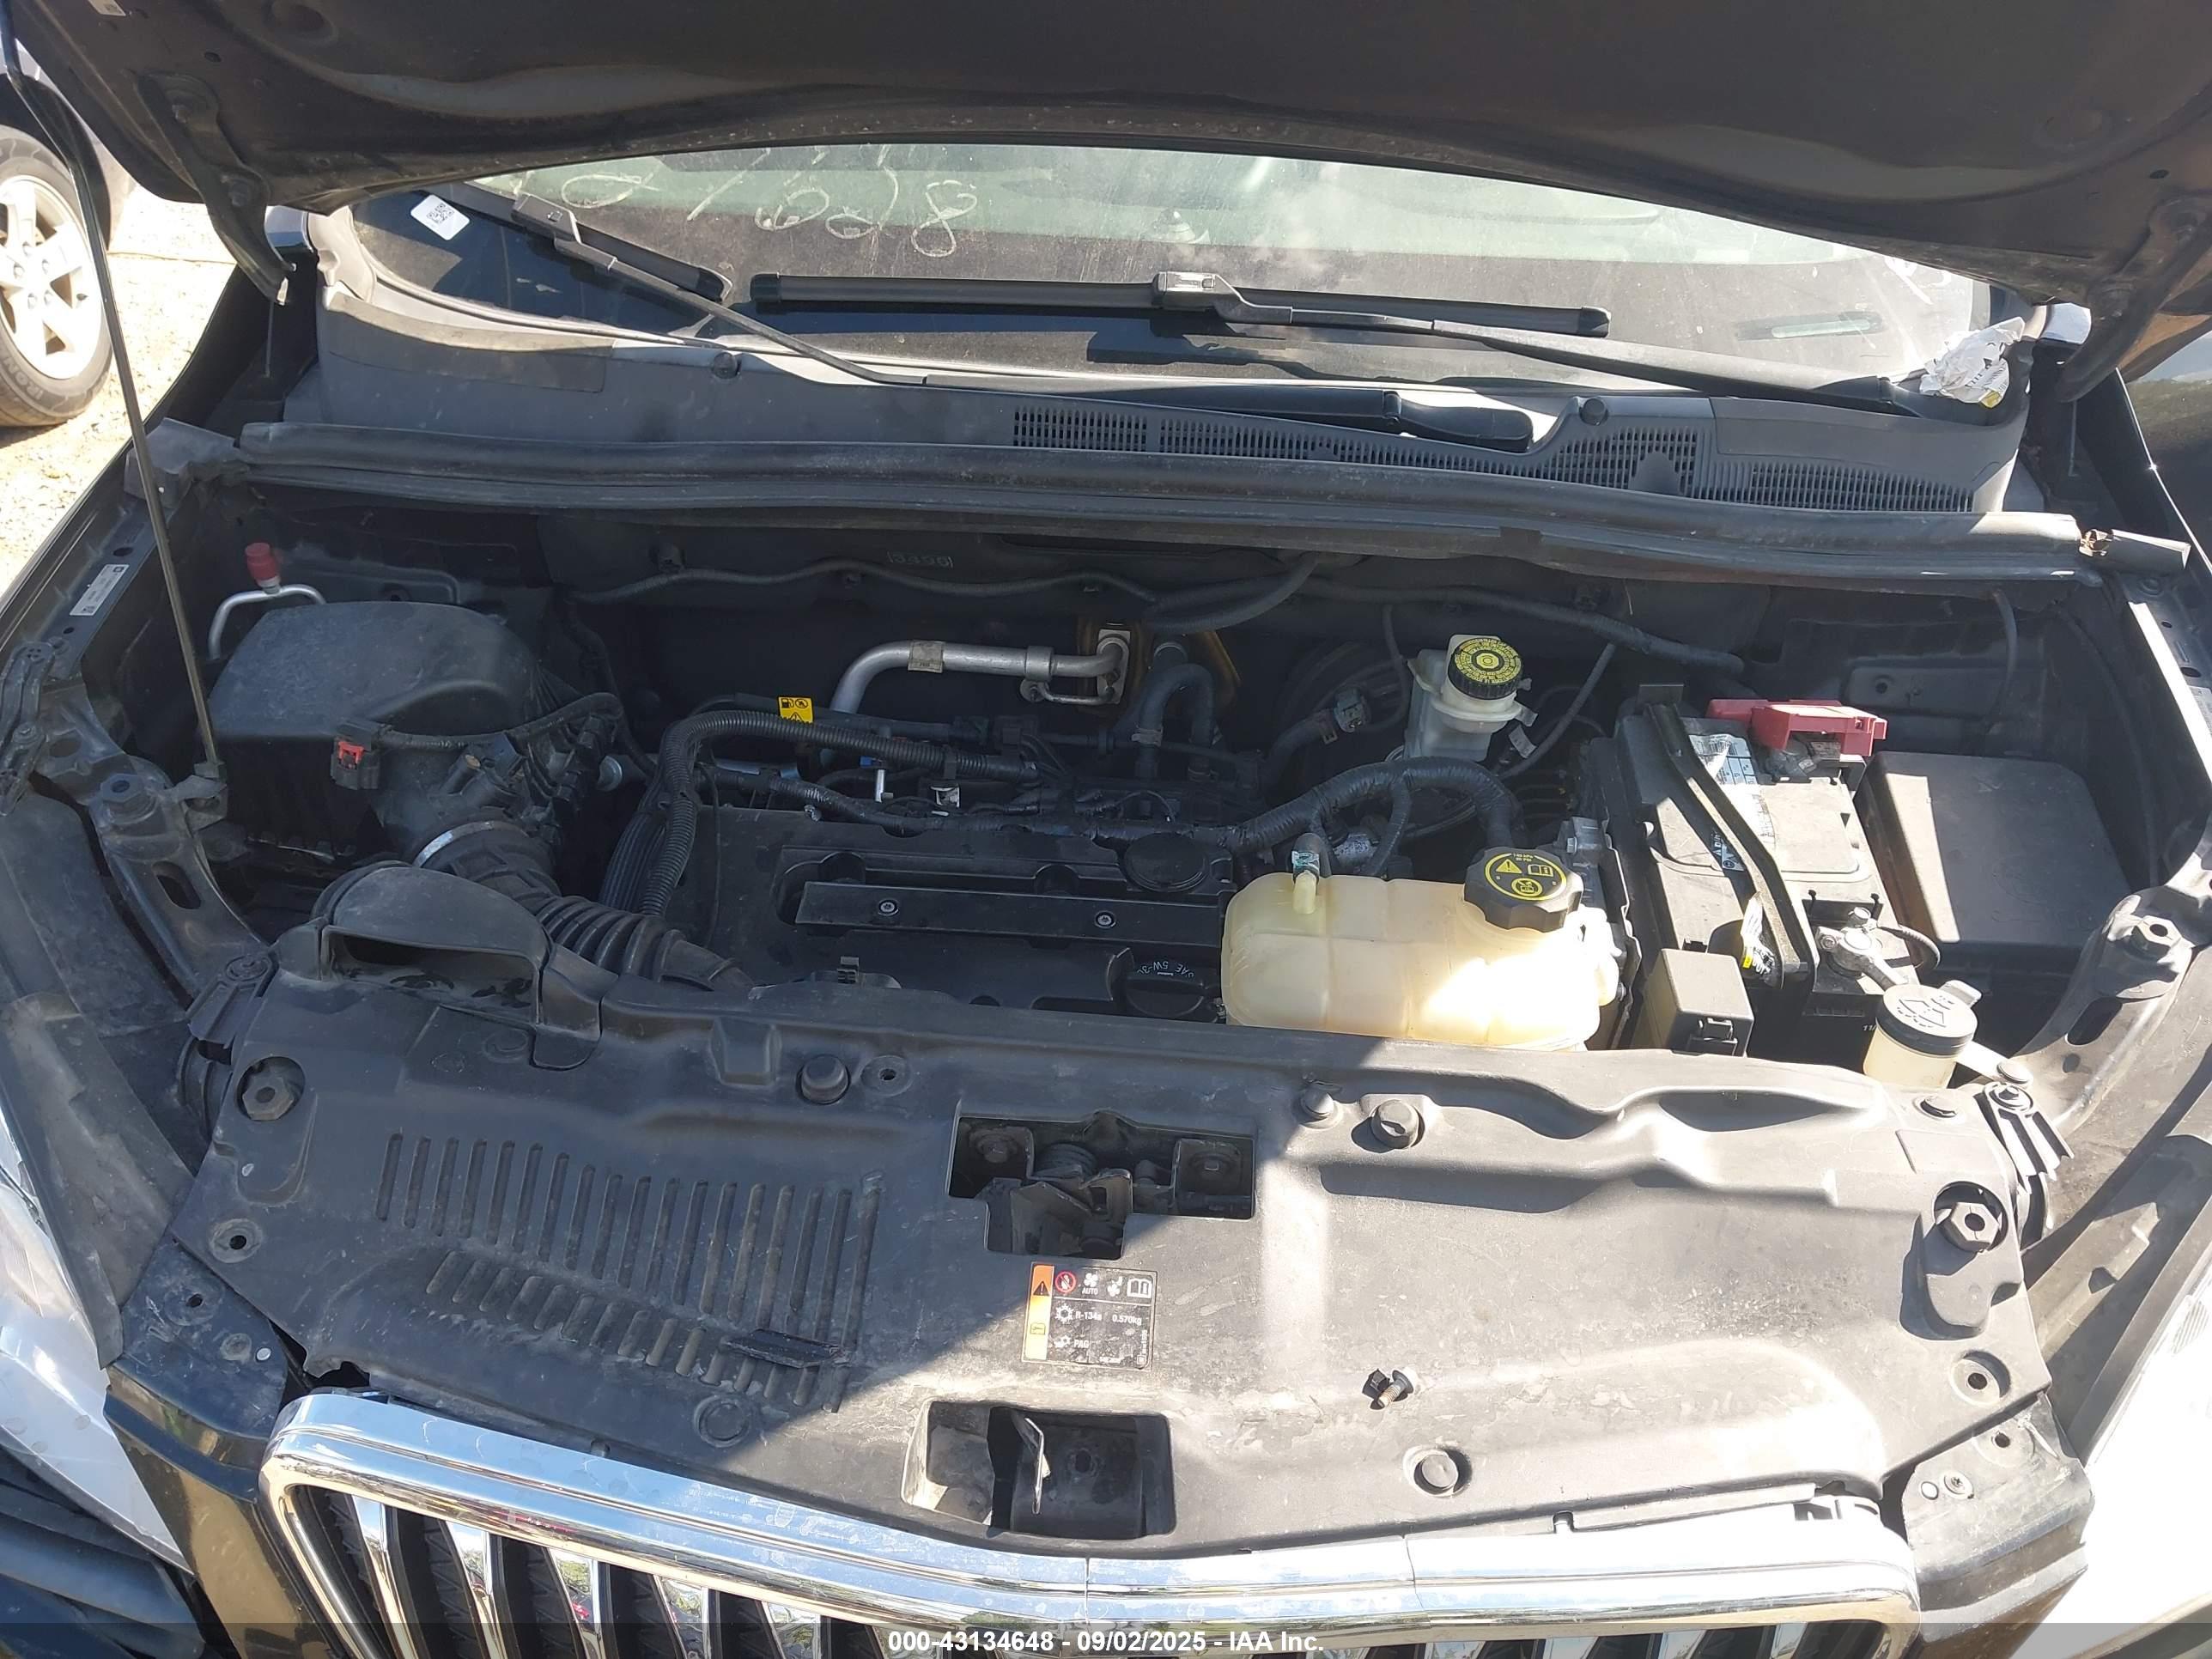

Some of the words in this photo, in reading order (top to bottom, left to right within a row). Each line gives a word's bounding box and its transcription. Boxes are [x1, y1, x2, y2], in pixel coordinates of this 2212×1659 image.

[1081, 1286, 1098, 1296] AUTO
[1112, 1314, 1142, 1326] 0.570kg
[1073, 1340, 1090, 1349] PAG
